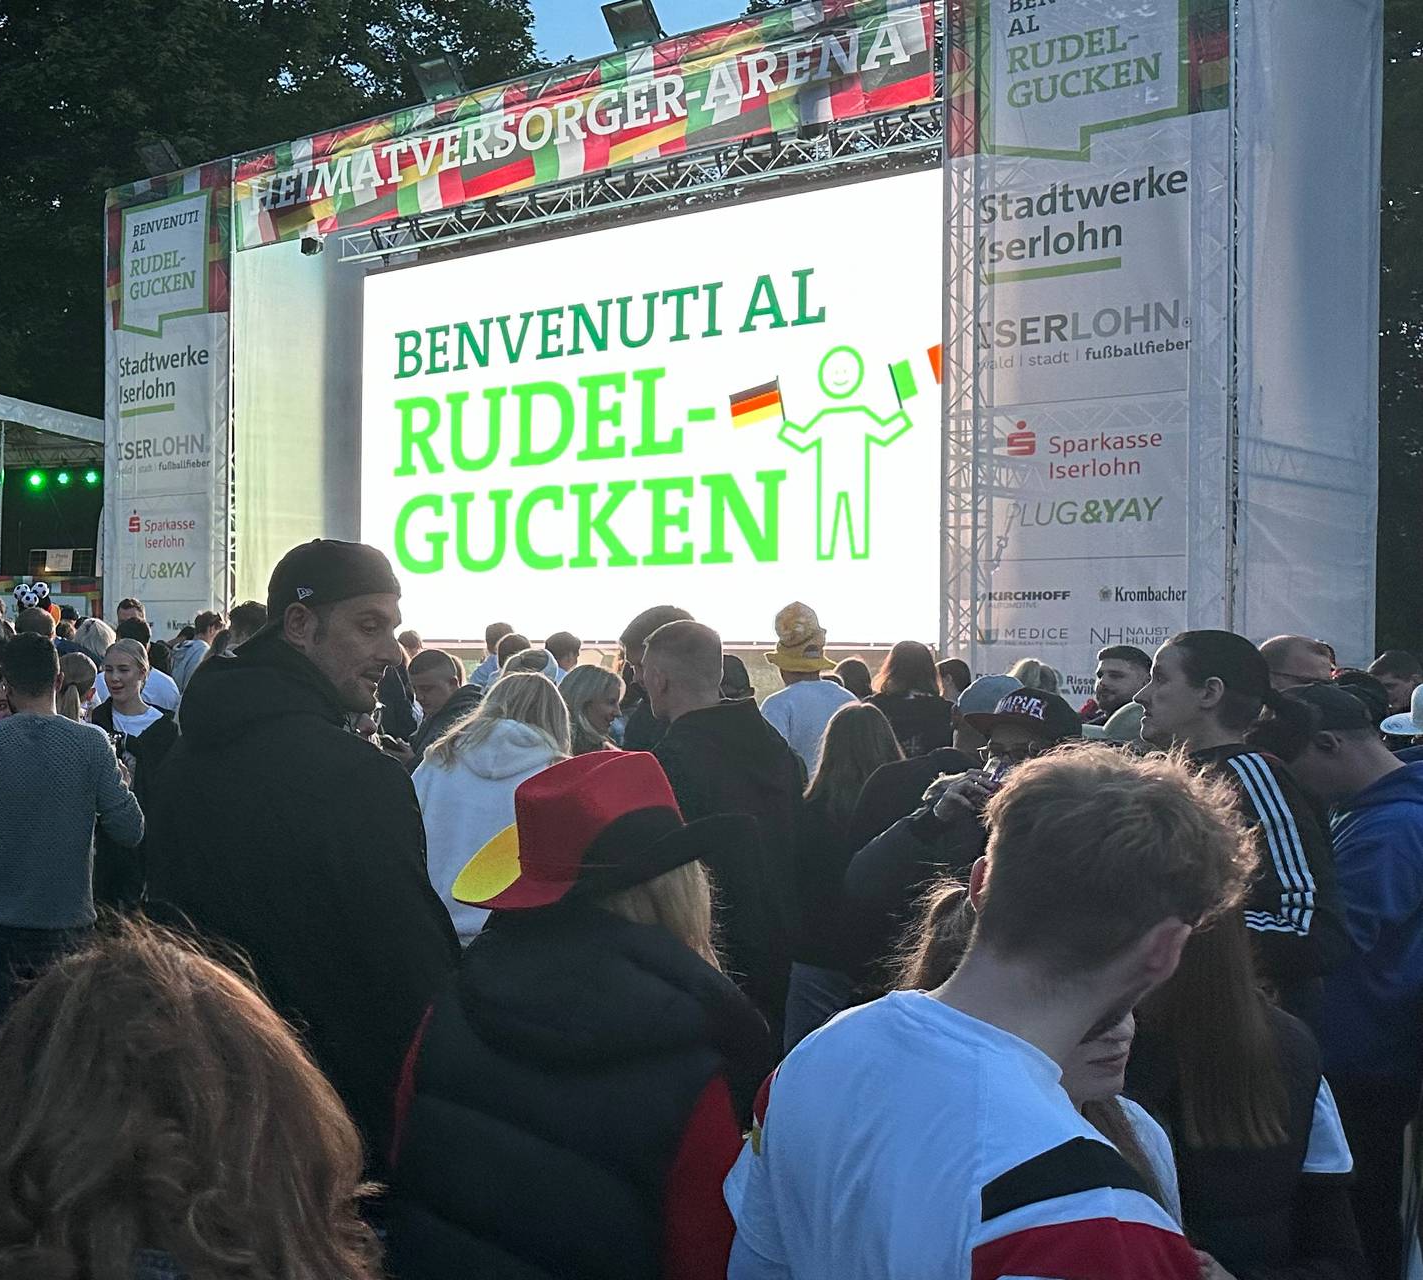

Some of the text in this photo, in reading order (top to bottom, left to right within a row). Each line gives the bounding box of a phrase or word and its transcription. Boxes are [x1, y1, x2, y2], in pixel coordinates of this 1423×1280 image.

[1007, 15, 1040, 38] AL
[1007, 25, 1139, 74] RUDEL-
[1007, 52, 1163, 108] GUCKEN
[249, 21, 911, 215] HEIMATVERSORGER-ARENA
[979, 166, 1188, 224] Stadtwerke
[132, 210, 200, 237] BENVENUTI
[131, 239, 146, 253] AL
[129, 250, 186, 277] RUDEL-
[129, 270, 196, 300] GUCKEN
[393, 267, 827, 379] BENVENUTI AL
[119, 345, 209, 377] Stadtwerke
[1028, 350, 1070, 367] stadt
[1085, 337, 1192, 361] fußballfieber
[119, 377, 175, 404] Iserlohn
[393, 366, 716, 477] RUDEL-
[1049, 431, 1163, 457] Sparkasse
[1049, 457, 1141, 479] Iserlohn
[394, 469, 787, 575] GUCKEN
[1006, 496, 1164, 527] PLUG&YAY
[144, 518, 195, 534] Sparkasse
[144, 535, 185, 549] Iserlohn
[988, 591, 1071, 601] KIRCHHOFF
[1115, 586, 1188, 602] Krombacher
[1004, 628, 1069, 639] MEDICE
[1126, 627, 1170, 636] NAUST
